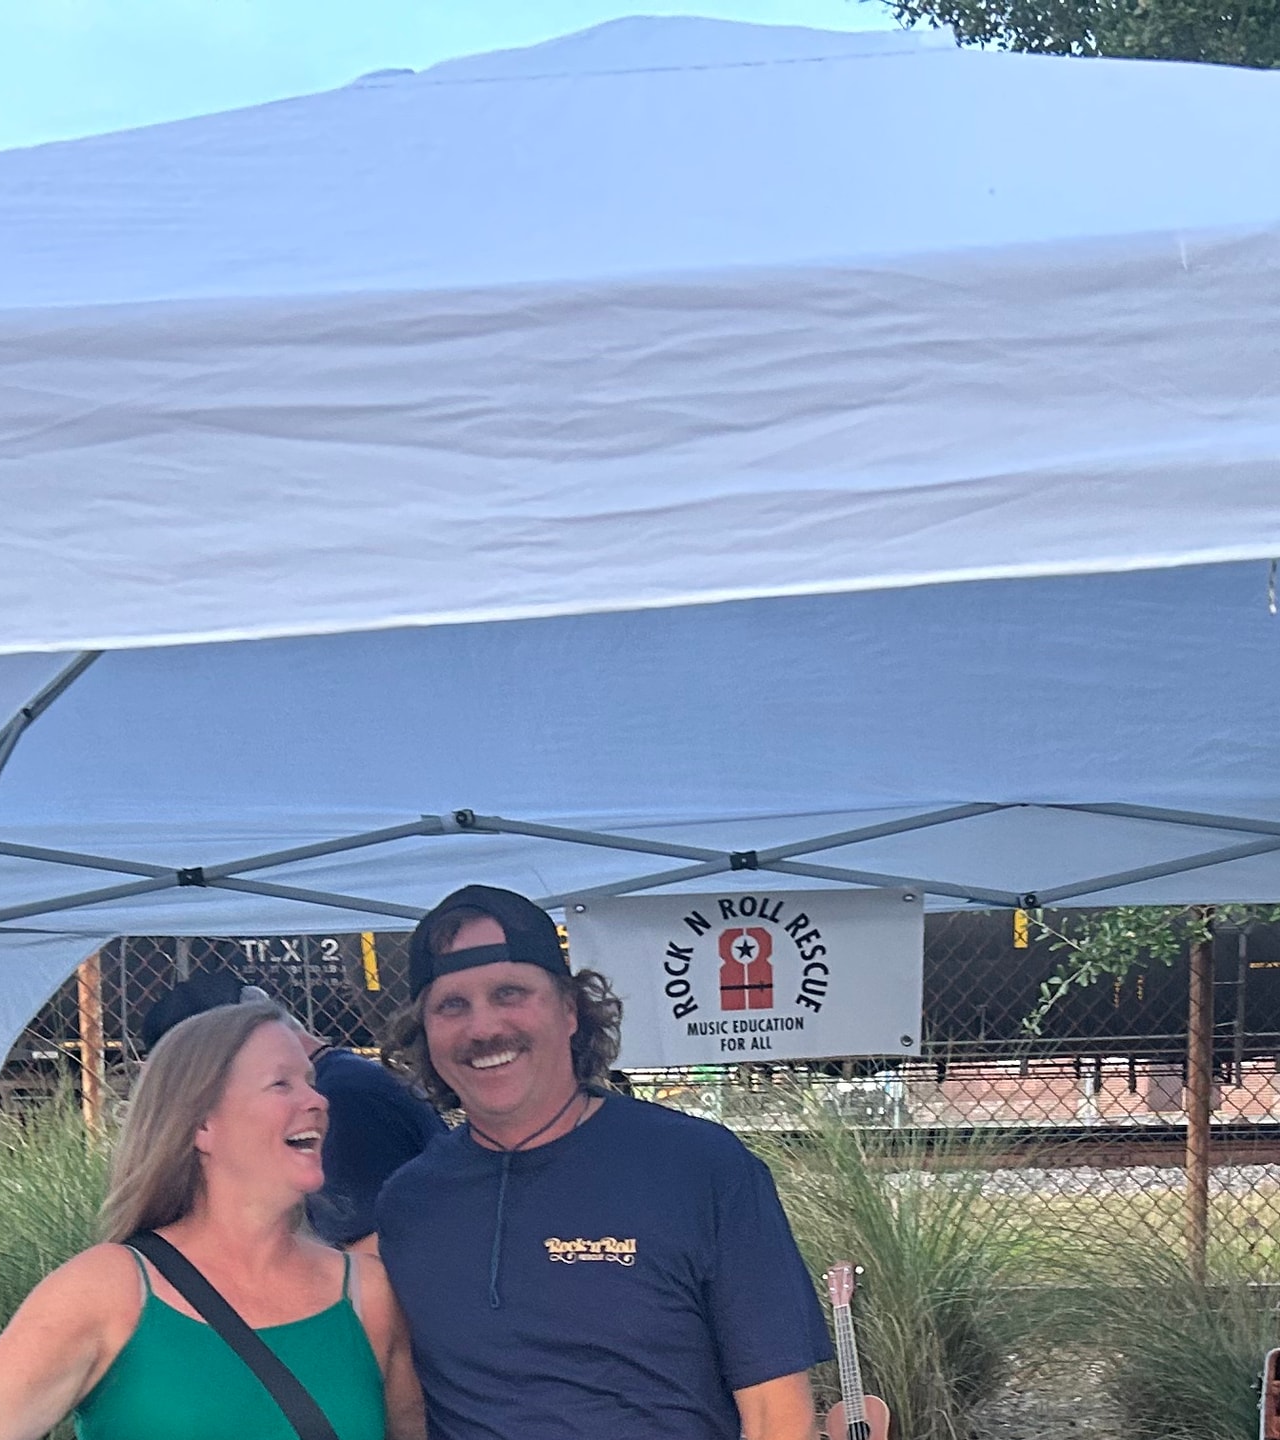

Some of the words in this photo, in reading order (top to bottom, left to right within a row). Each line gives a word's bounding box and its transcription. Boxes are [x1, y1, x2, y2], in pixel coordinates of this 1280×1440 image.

[664, 941, 699, 1019] ROCK
[683, 910, 712, 937] N
[717, 896, 784, 923] ROLL
[784, 913, 830, 1014] RESCUE
[687, 1020, 729, 1036] MUSIC
[733, 1017, 805, 1034] EDUCATION
[721, 1037, 746, 1052] FOR
[751, 1036, 773, 1050] ALL
